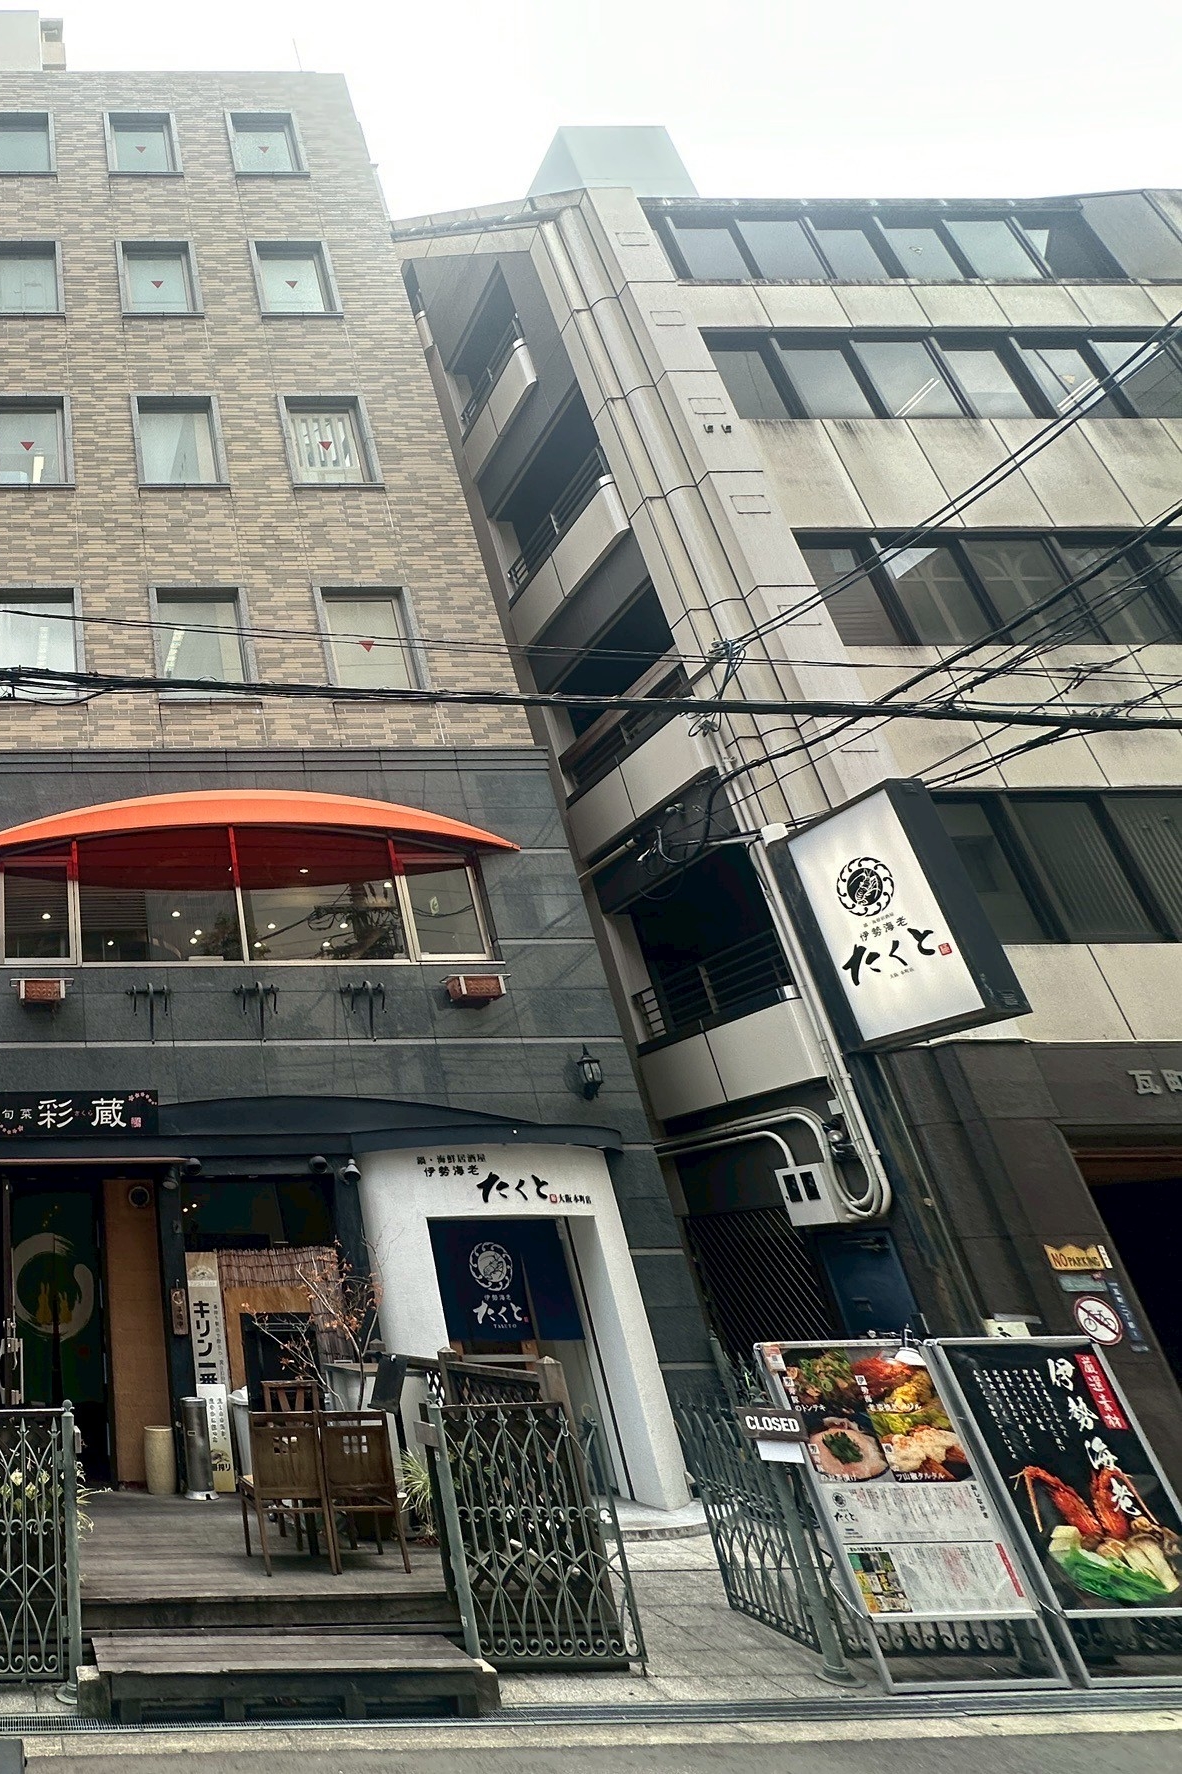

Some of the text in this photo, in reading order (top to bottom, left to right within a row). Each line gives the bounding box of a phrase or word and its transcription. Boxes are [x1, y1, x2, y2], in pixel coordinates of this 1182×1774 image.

[842, 928, 936, 986] たくと
[2, 1108, 32, 1120] 旬菜
[424, 1165, 480, 1178] 伊勢海老
[476, 1171, 549, 1204] たくと
[1051, 1253, 1068, 1268] NO
[1068, 1256, 1101, 1268] PARKING
[472, 1300, 522, 1324] たくと
[745, 1415, 800, 1432] CLOSED
